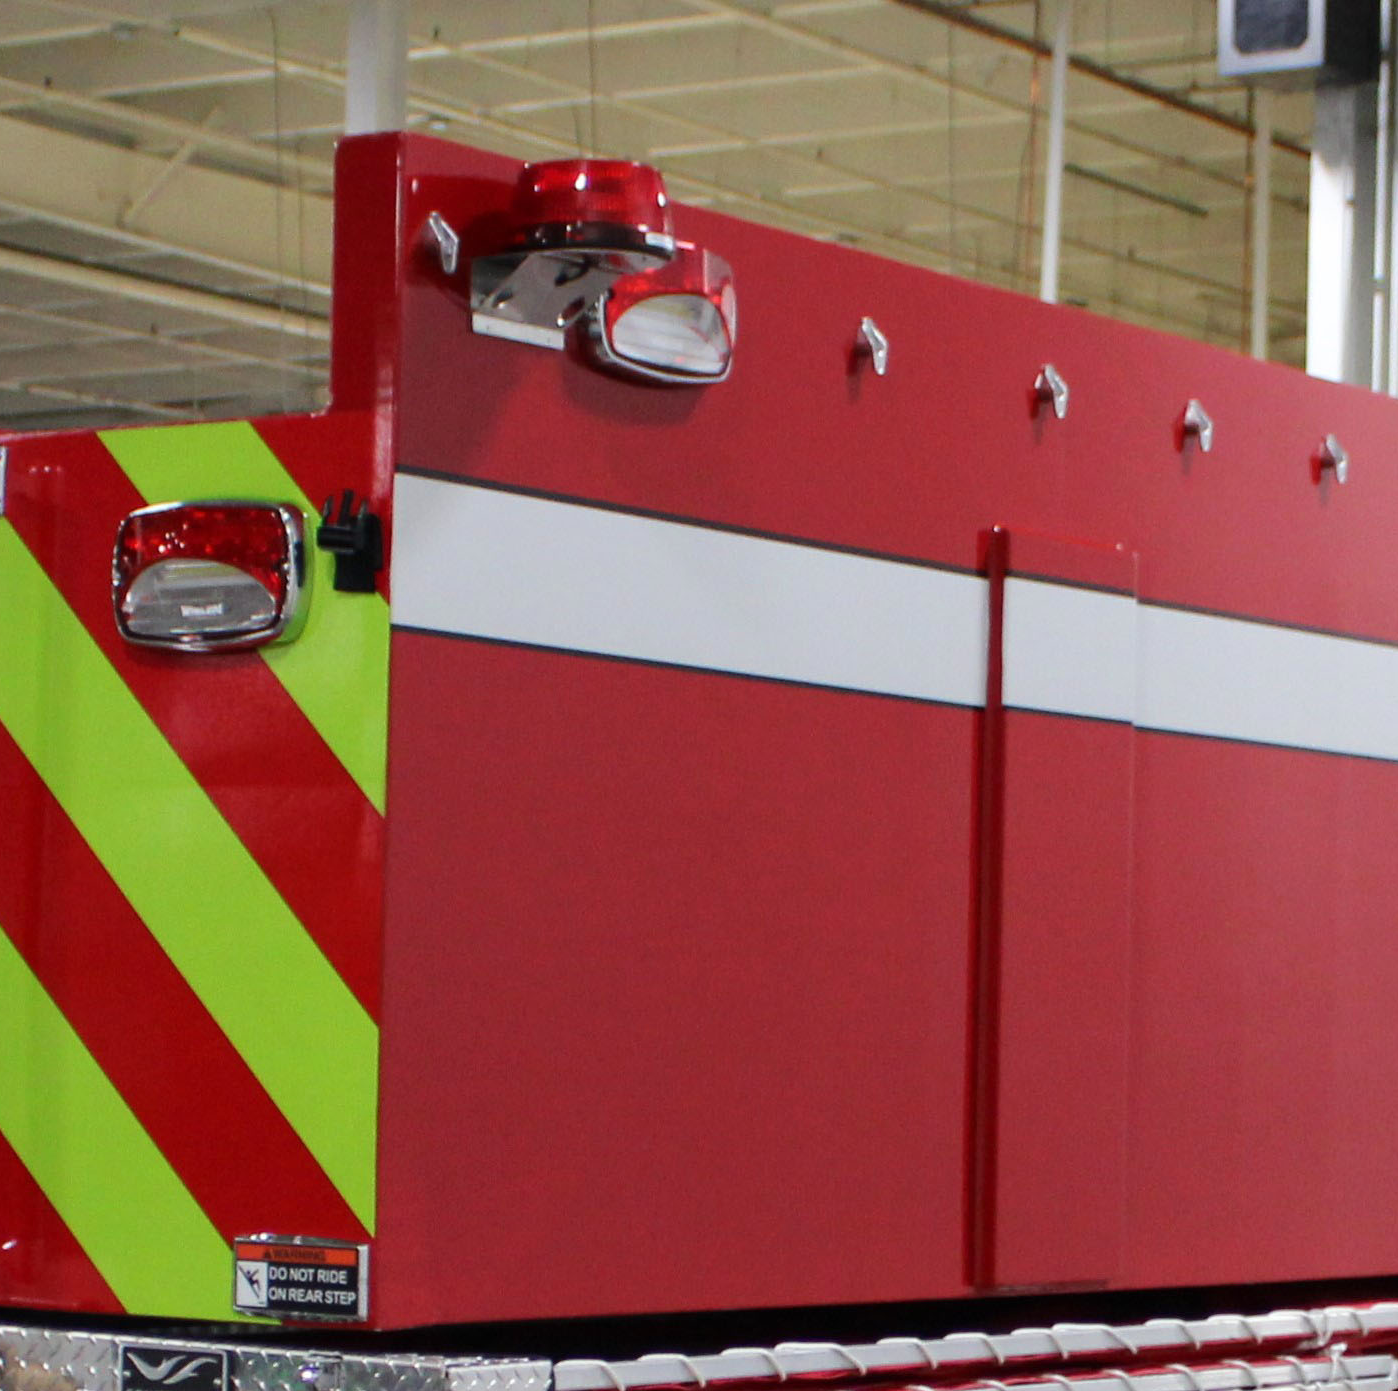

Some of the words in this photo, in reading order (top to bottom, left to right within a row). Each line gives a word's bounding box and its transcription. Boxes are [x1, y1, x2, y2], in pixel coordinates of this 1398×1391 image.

[268, 1266, 288, 1280] DO
[289, 1268, 315, 1282] NOT
[317, 1269, 348, 1285] RIDE
[268, 1286, 287, 1301] ON
[288, 1288, 324, 1304] REAR
[324, 1290, 357, 1306] STEP
